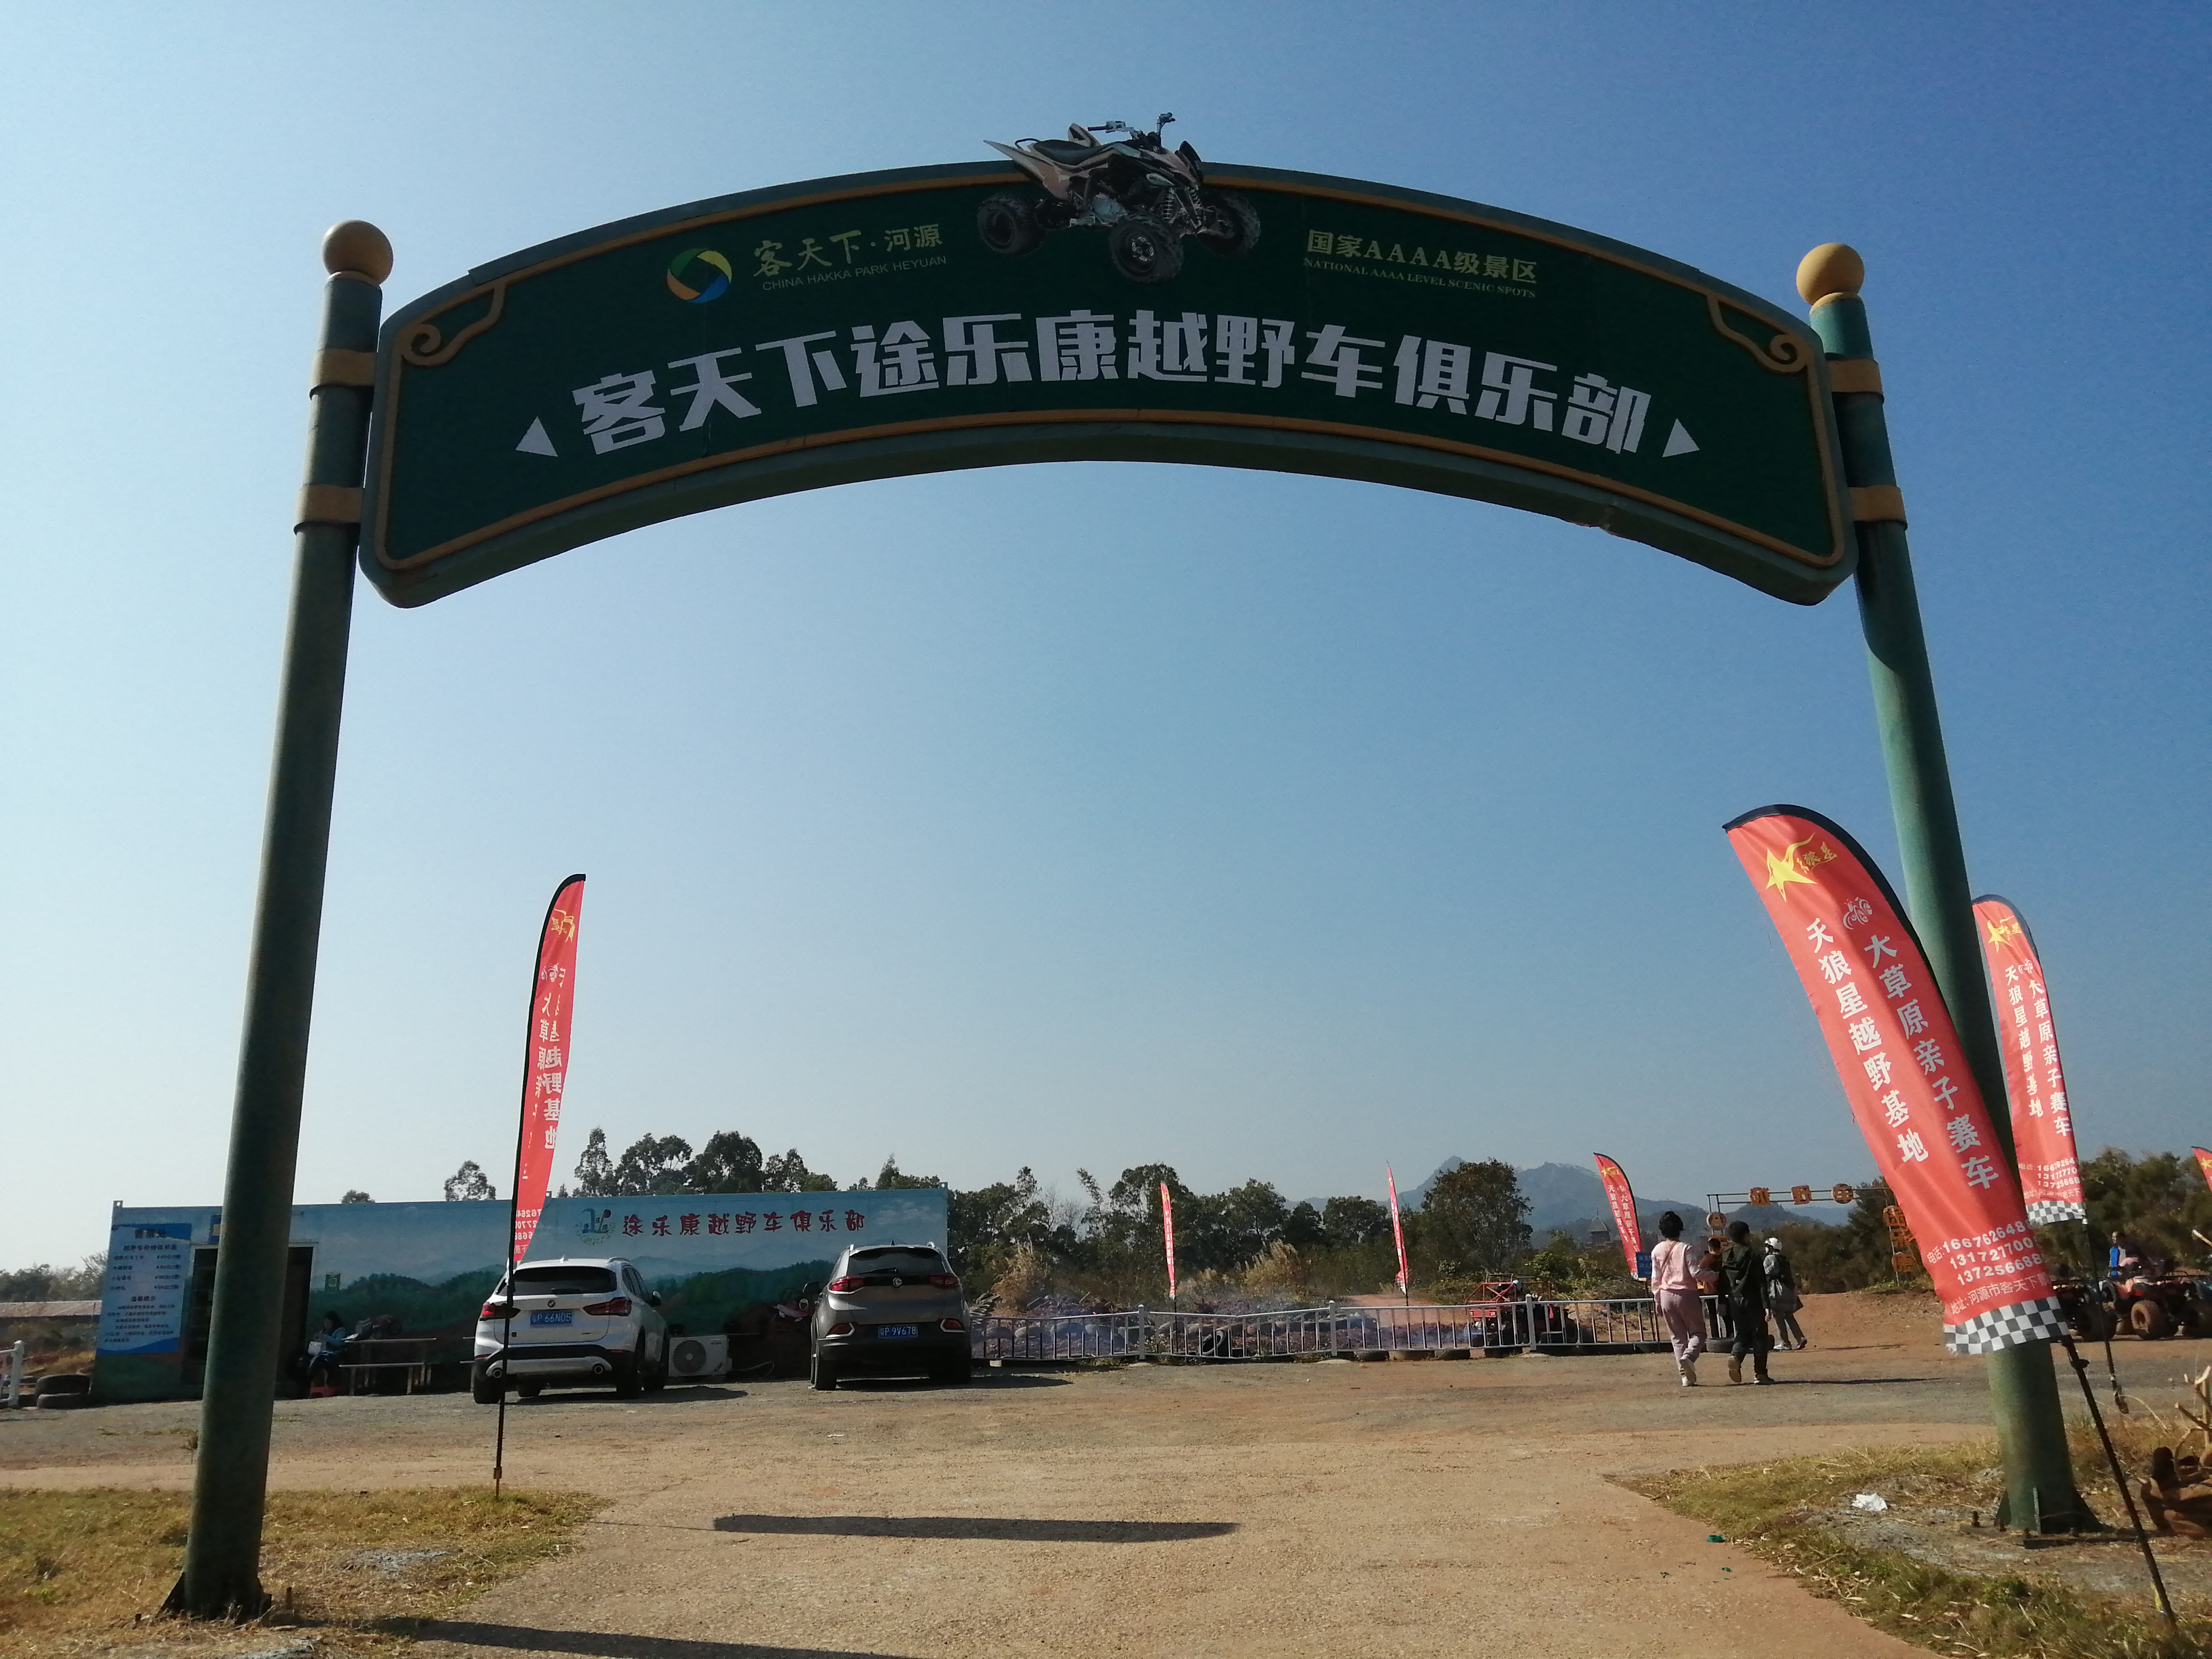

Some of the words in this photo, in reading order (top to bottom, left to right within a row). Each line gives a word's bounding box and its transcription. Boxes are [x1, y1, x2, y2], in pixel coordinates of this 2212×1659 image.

[763, 276, 804, 291] CHINA
[808, 270, 852, 283] HAKKA
[855, 264, 889, 277] PARK
[893, 256, 946, 271] HEYUAN
[1303, 257, 1368, 275] NATIONAL
[1370, 269, 1404, 281] AAAA
[1407, 273, 1446, 287] LEVEL
[1448, 279, 1495, 292] SCENIC
[1497, 285, 1536, 299] SPOTS
[1307, 229, 1537, 284] 国家AAAA级景区
[572, 310, 1652, 455] 客天下途乐康越野车俱乐部
[1806, 917, 1929, 1163] 天狼星越野基地
[1864, 934, 1998, 1189] 大草原亲子赛车
[2029, 979, 2072, 1137] 大草原亲子赛车
[622, 1210, 865, 1236] 途乐康越野车俱乐部
[892, 1326, 916, 1336] 9V678
